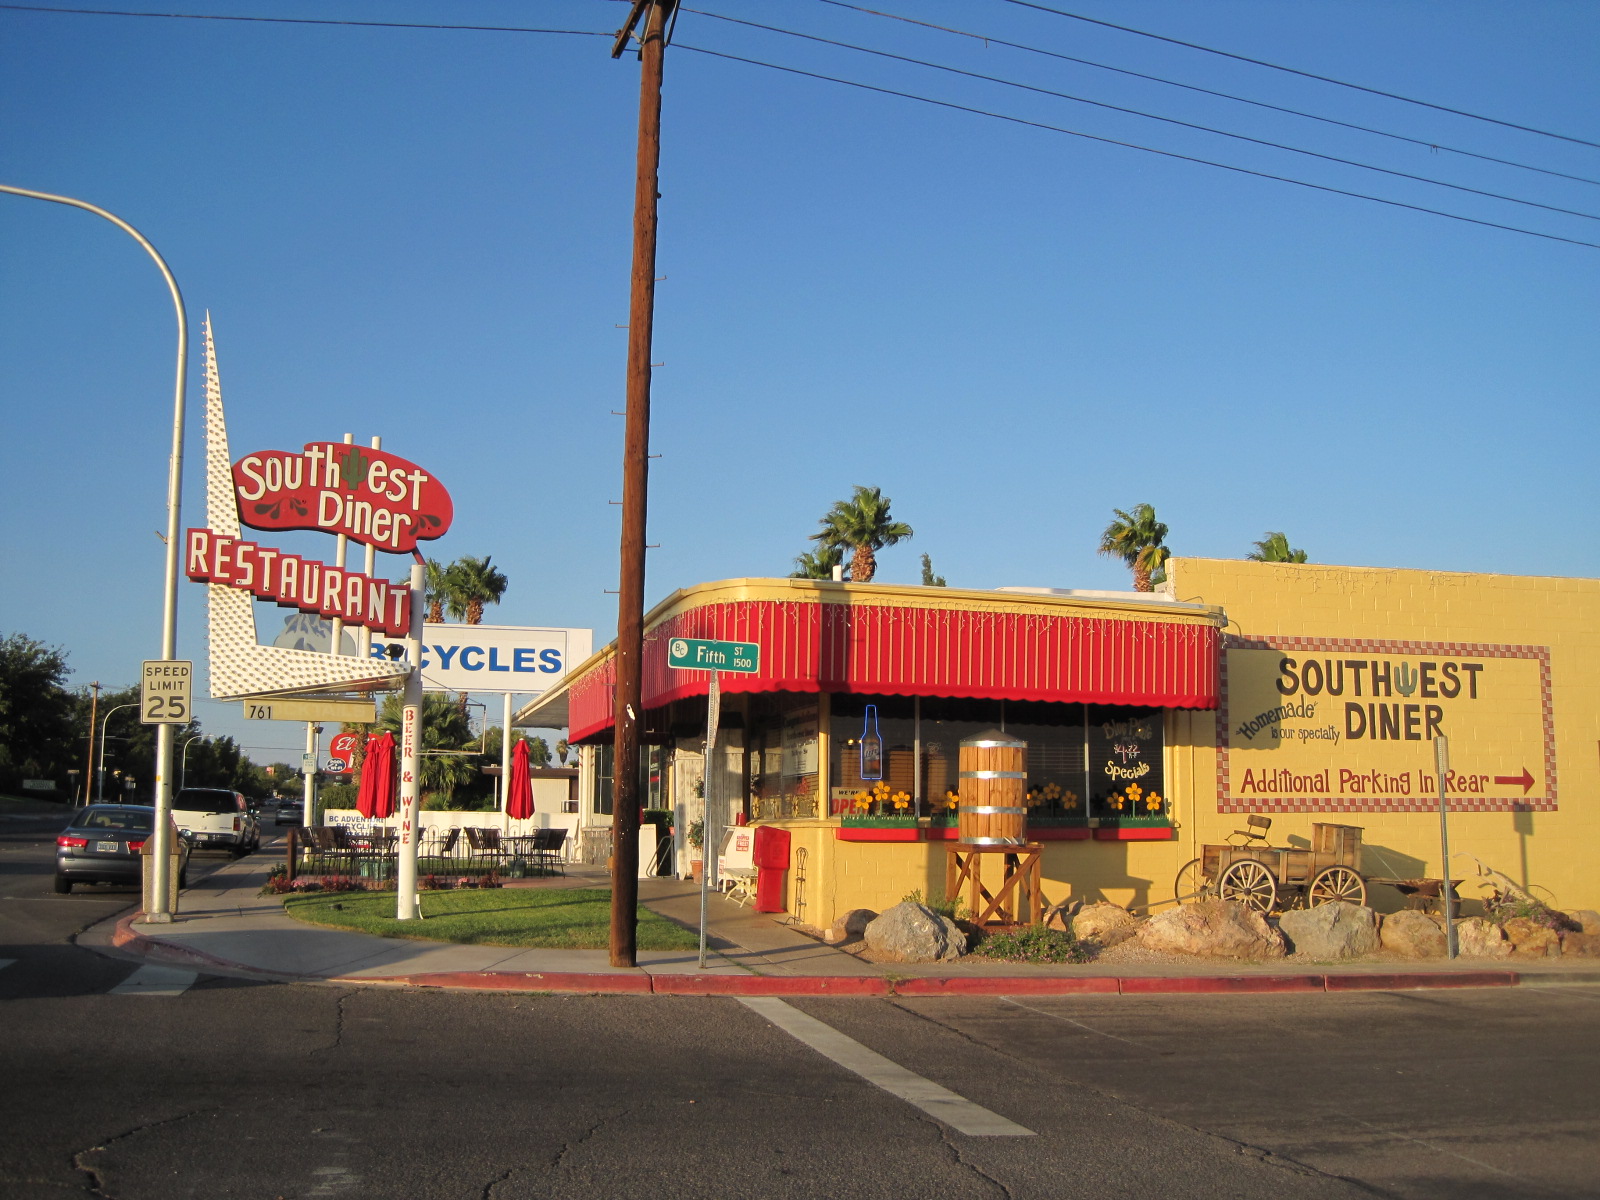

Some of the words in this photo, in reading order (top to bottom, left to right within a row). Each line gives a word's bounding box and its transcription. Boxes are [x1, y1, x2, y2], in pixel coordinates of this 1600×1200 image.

[317, 490, 412, 549] Diner
[190, 531, 407, 628] RESTAURANT
[371, 642, 563, 674] BCYCLES
[696, 646, 726, 664] Fifth
[734, 646, 744, 656] ST
[733, 658, 752, 668] 1500
[146, 666, 189, 677] SPEED
[150, 681, 185, 691] LIMIT
[147, 695, 186, 719] 25
[250, 705, 272, 719] 761
[404, 709, 415, 758] BEER
[1344, 702, 1444, 741] DINER
[1280, 728, 1295, 739] our
[1298, 724, 1341, 746] specialty
[1104, 760, 1150, 781] Specials
[1240, 768, 1330, 794] Additional
[1338, 768, 1411, 796] Parking
[1418, 768, 1434, 794] In
[1443, 768, 1490, 794] Rear
[402, 795, 414, 844] WINE
